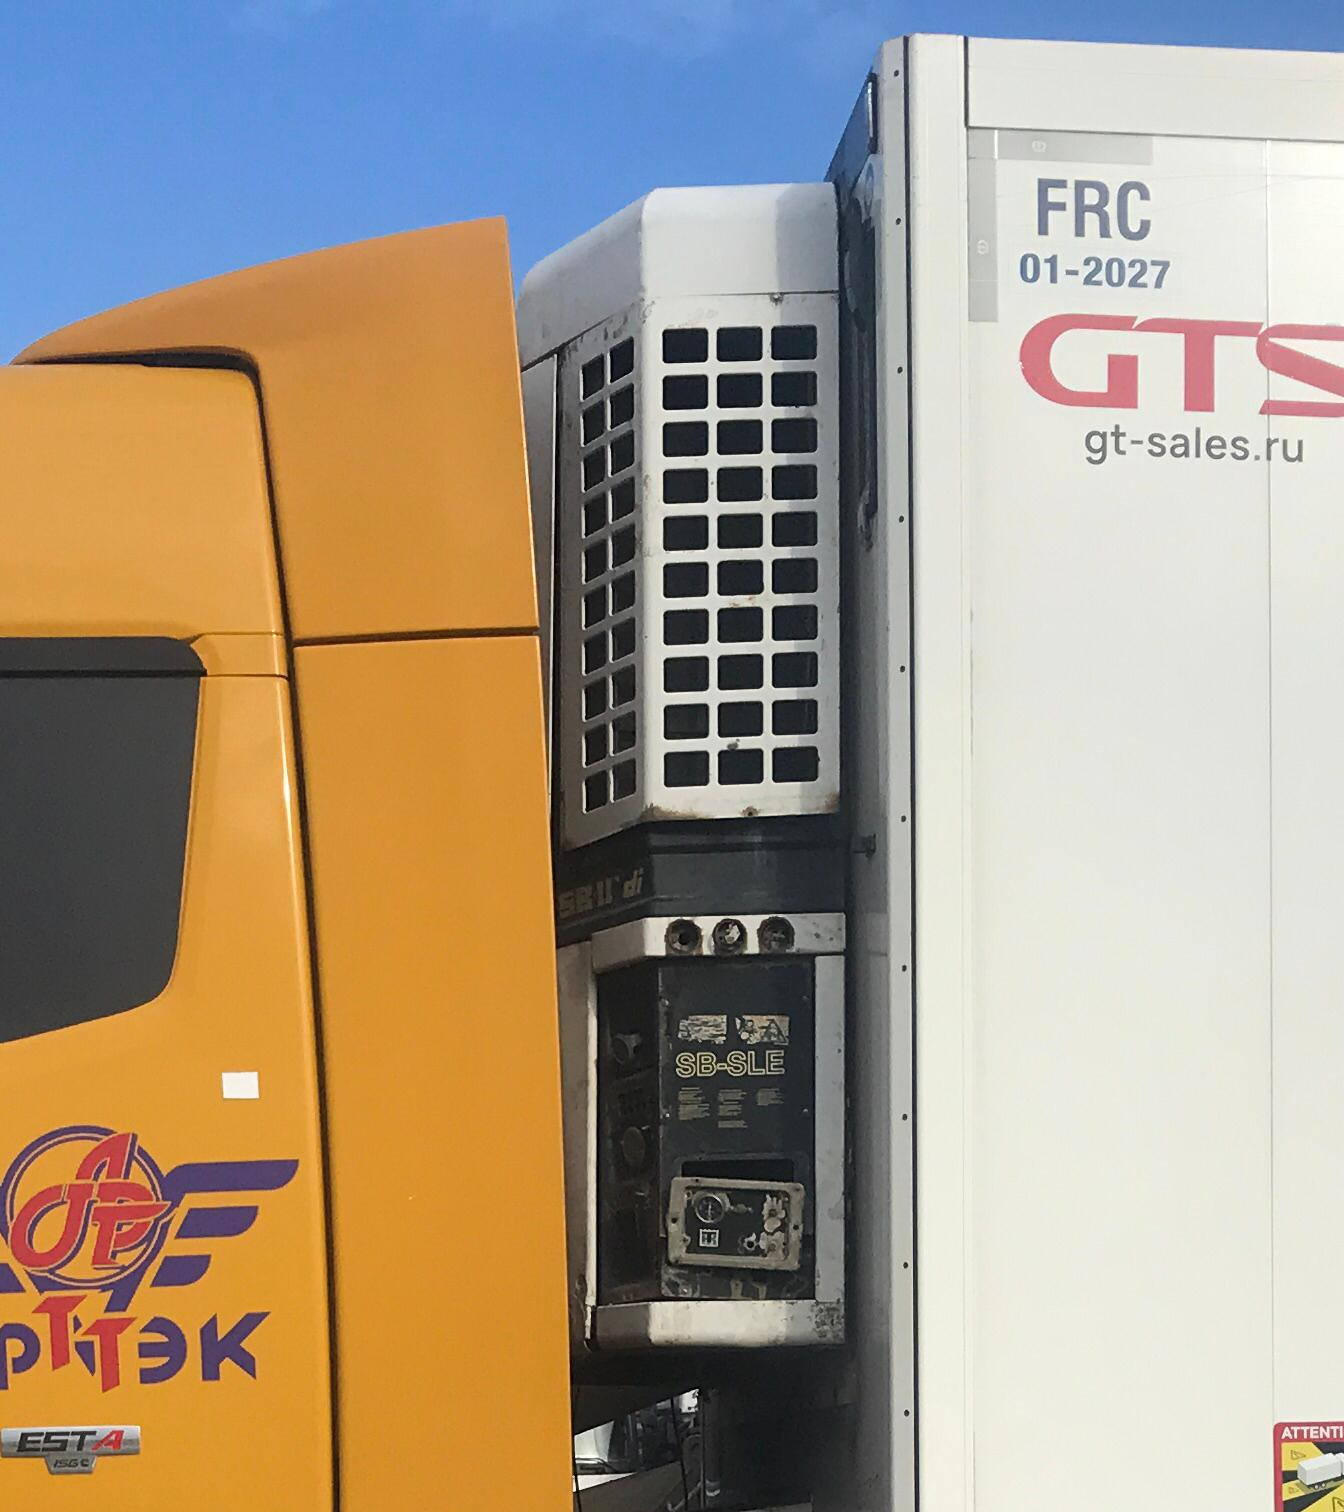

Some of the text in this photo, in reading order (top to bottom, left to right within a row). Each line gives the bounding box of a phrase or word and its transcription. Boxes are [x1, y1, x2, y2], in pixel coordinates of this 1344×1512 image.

[1037, 177, 1152, 241] FRC
[1018, 252, 1171, 289] 01-2027
[1083, 423, 1305, 465] gt-sales.ru
[675, 1050, 786, 1078] SB-SLE
[16, 1430, 125, 1452] ESTA
